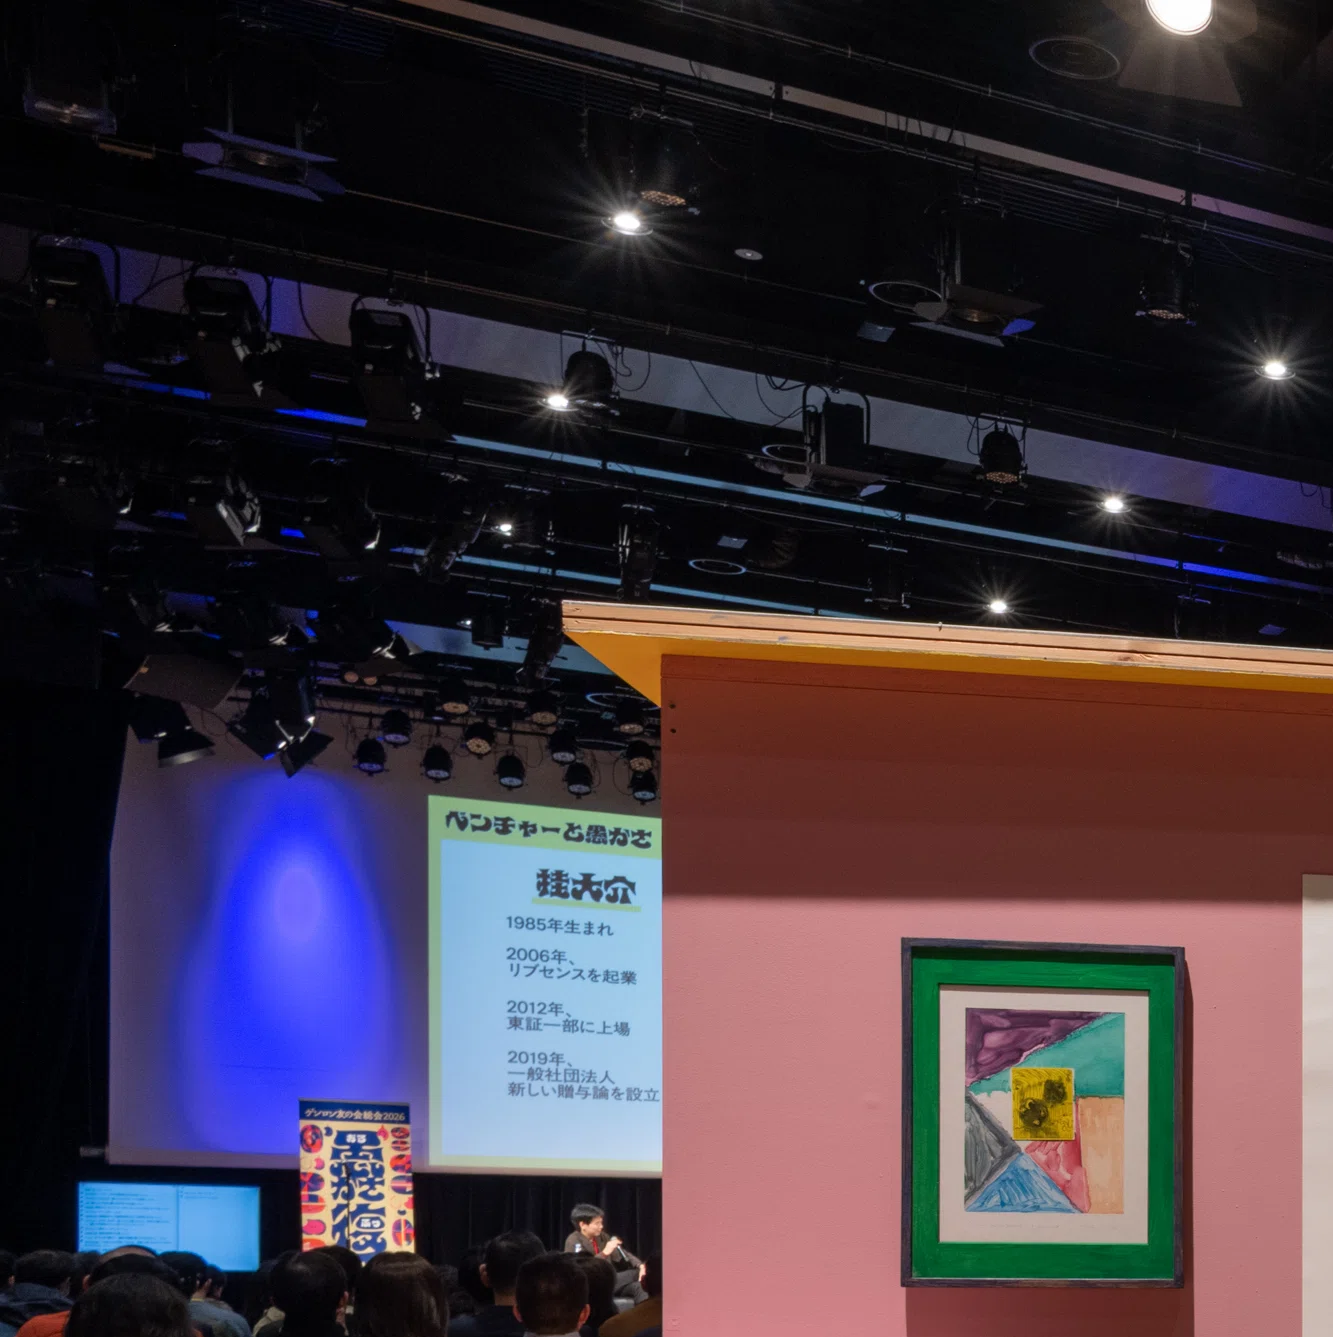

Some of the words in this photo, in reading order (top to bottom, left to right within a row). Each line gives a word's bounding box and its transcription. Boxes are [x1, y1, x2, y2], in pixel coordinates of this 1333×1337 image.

[446, 811, 652, 849] ベンチャーと愚かさ
[536, 868, 637, 904] 桂大介
[507, 916, 615, 936] 1985年生まれ
[506, 947, 575, 966] 2006年、
[509, 963, 637, 985] リブセンスを起業
[506, 1000, 572, 1018] 2012年、
[507, 1016, 631, 1037] 東証一部に上場
[507, 1051, 573, 1067] 2019年、
[508, 1067, 615, 1085] 一般社団法人
[508, 1082, 660, 1102] 新しい贈与論を設立
